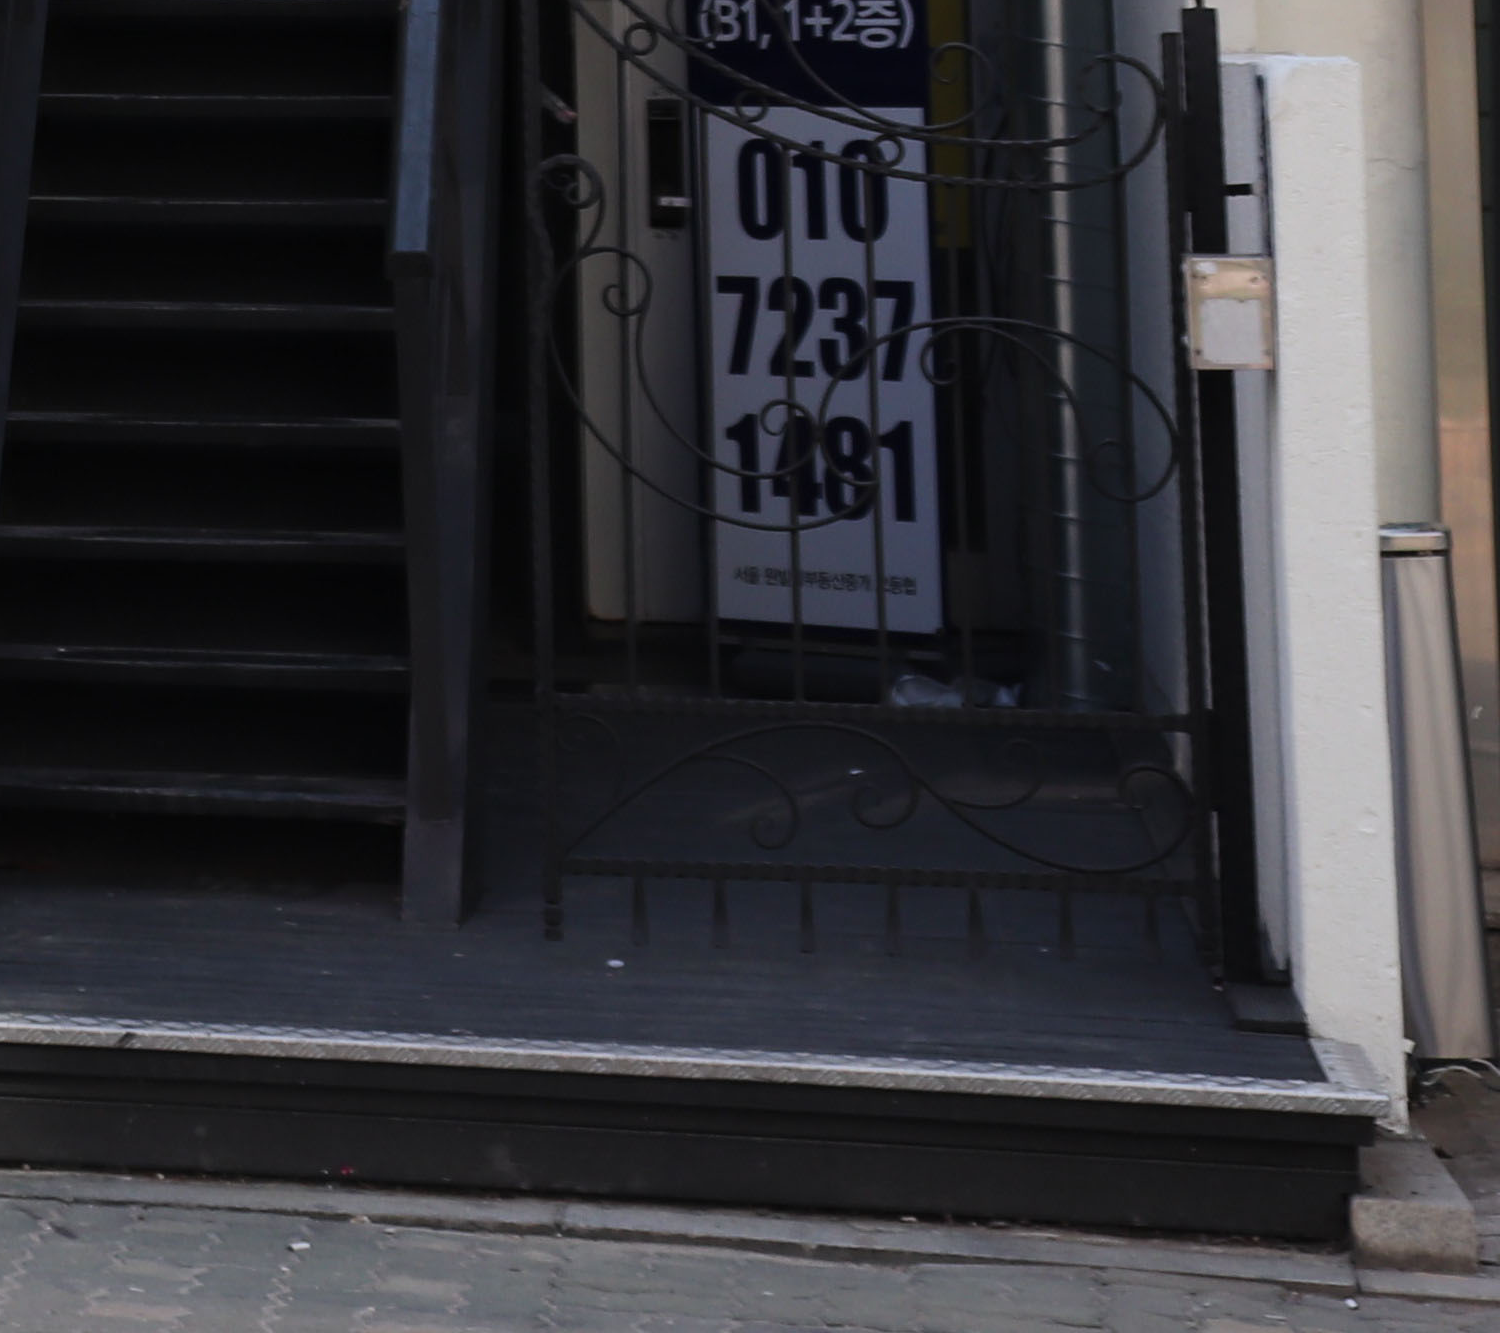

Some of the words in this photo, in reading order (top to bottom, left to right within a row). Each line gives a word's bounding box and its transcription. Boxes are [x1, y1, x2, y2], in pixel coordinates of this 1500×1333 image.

[737, 138, 892, 241] 010
[715, 275, 917, 383] 7237
[725, 412, 918, 524] 1481
